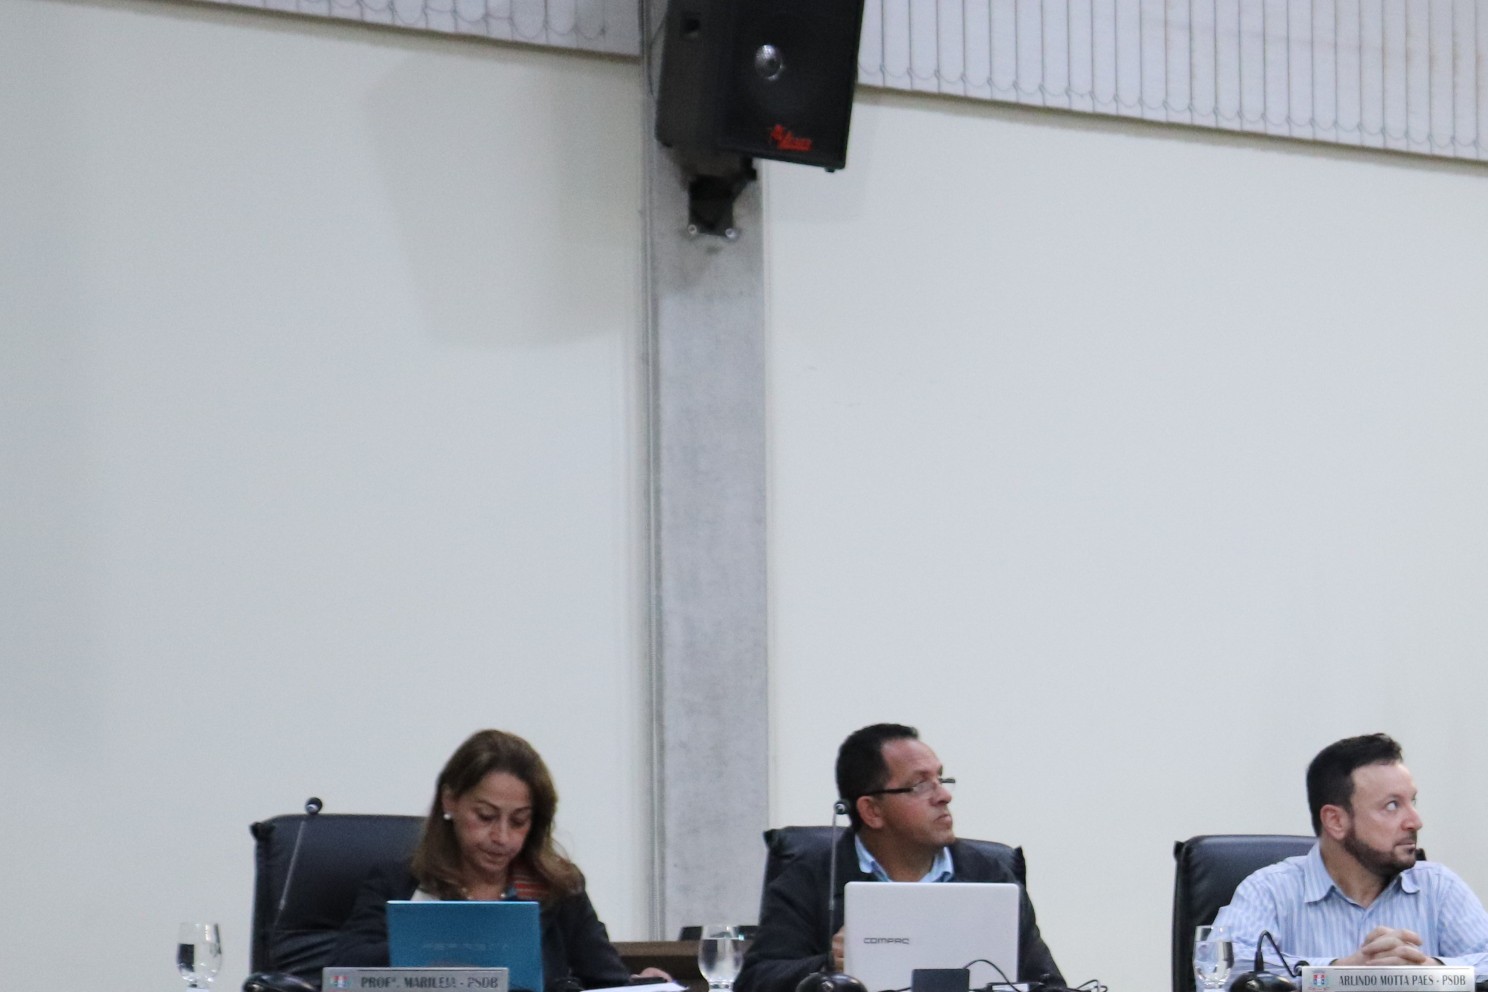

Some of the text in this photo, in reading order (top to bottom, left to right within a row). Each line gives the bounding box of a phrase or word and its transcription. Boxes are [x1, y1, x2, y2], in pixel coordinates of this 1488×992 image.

[1338, 975, 1377, 985] ARLINDO
[1380, 975, 1410, 985] MOTTA
[1412, 975, 1434, 985] PAES
[1442, 975, 1466, 985] PSDB
